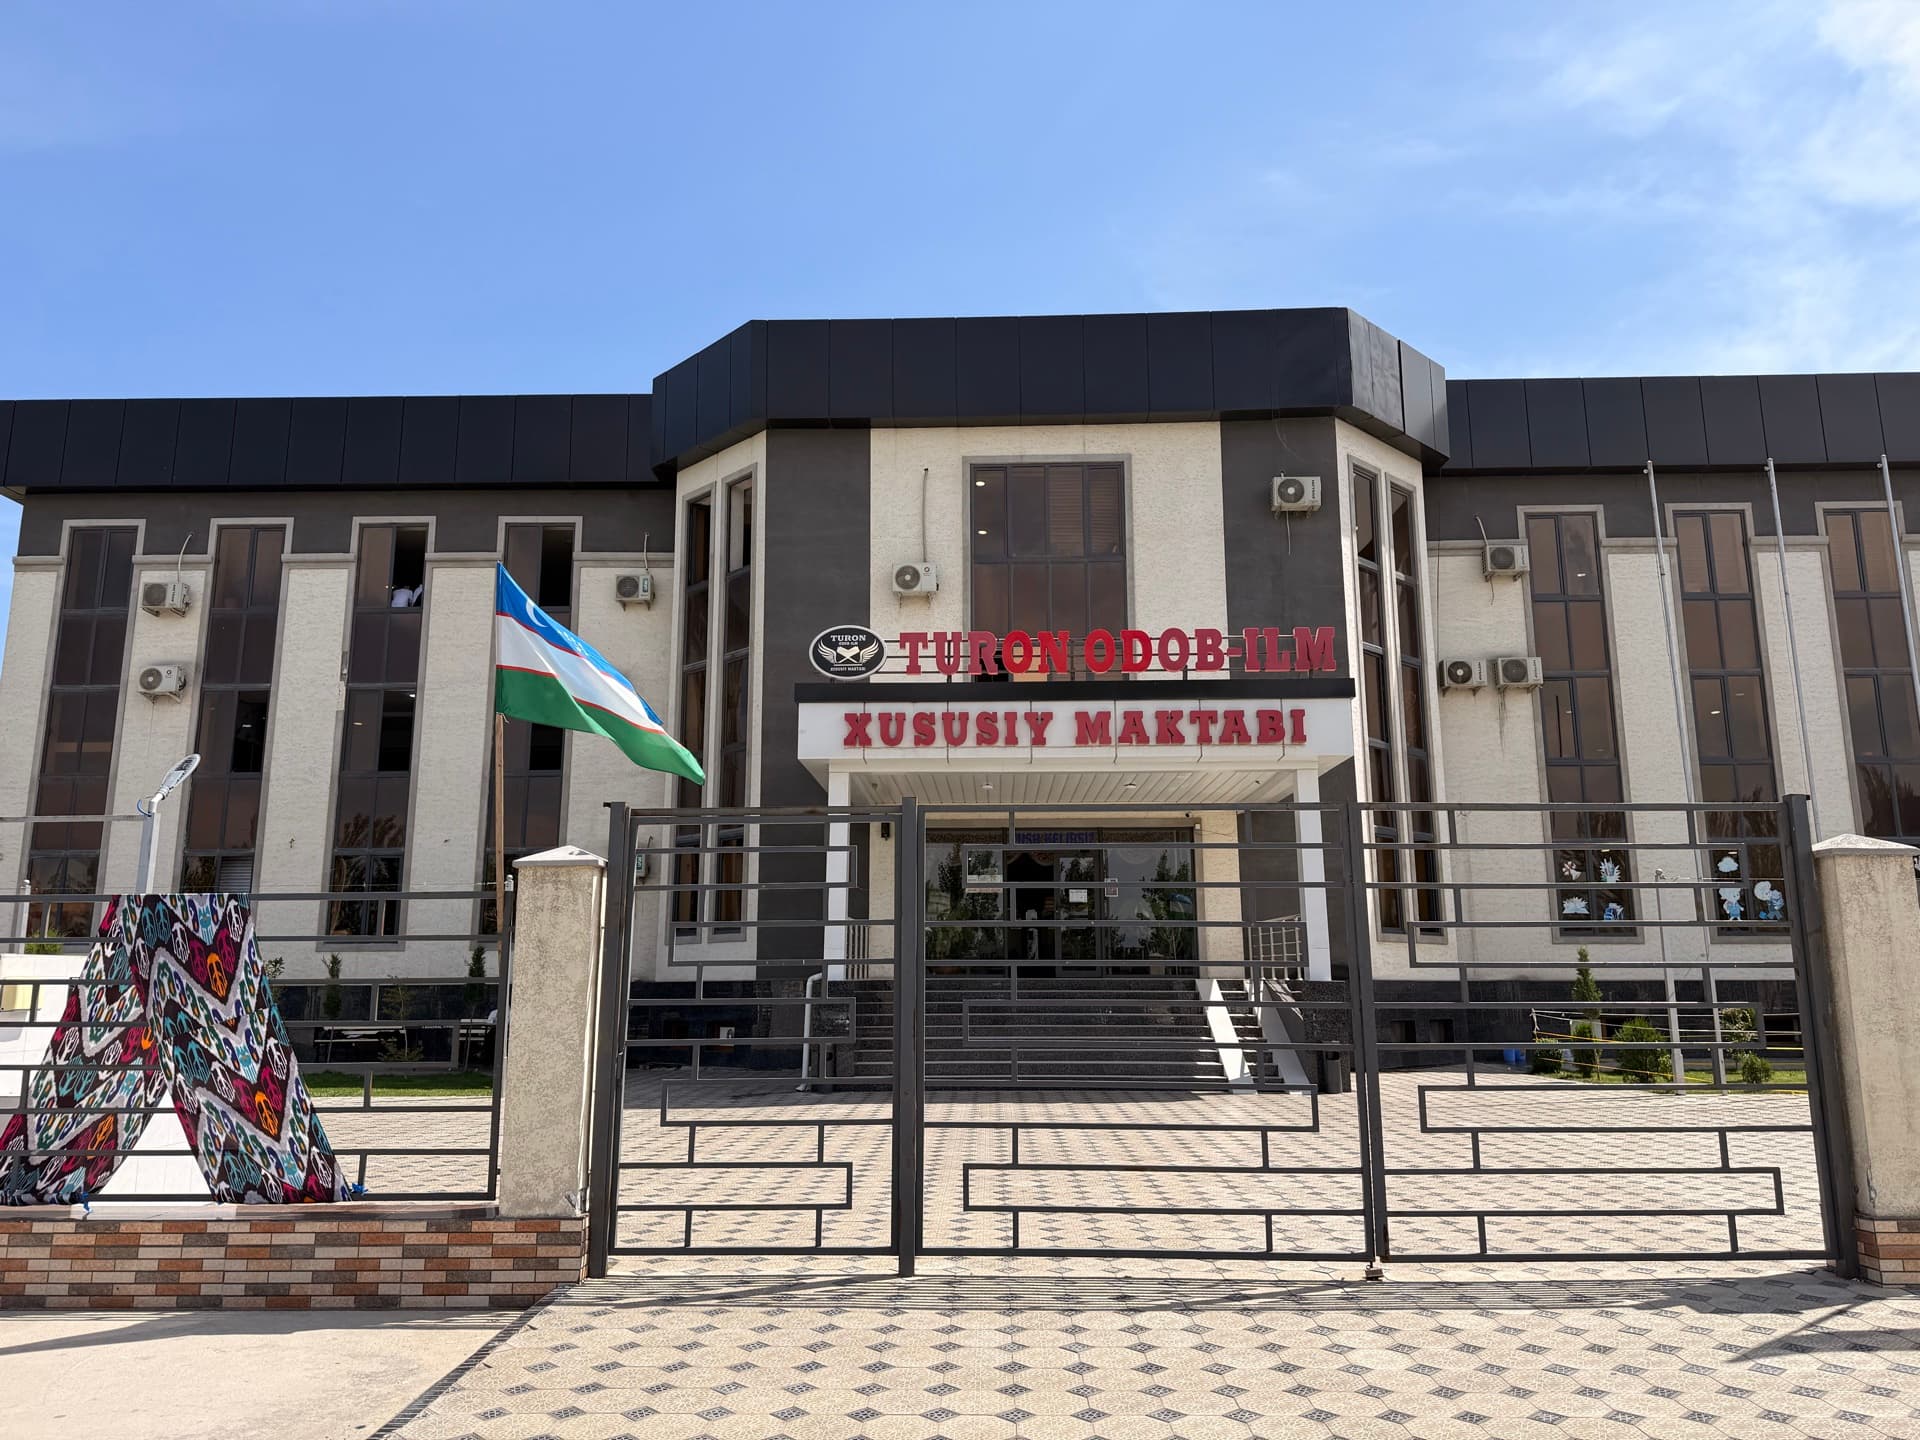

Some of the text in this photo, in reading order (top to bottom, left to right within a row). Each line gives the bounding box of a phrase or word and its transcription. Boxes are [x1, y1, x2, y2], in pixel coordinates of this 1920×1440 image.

[900, 627, 1336, 675] TURON ODOB-ILM
[843, 709, 1307, 746] XUSUSIY MAKTABI
